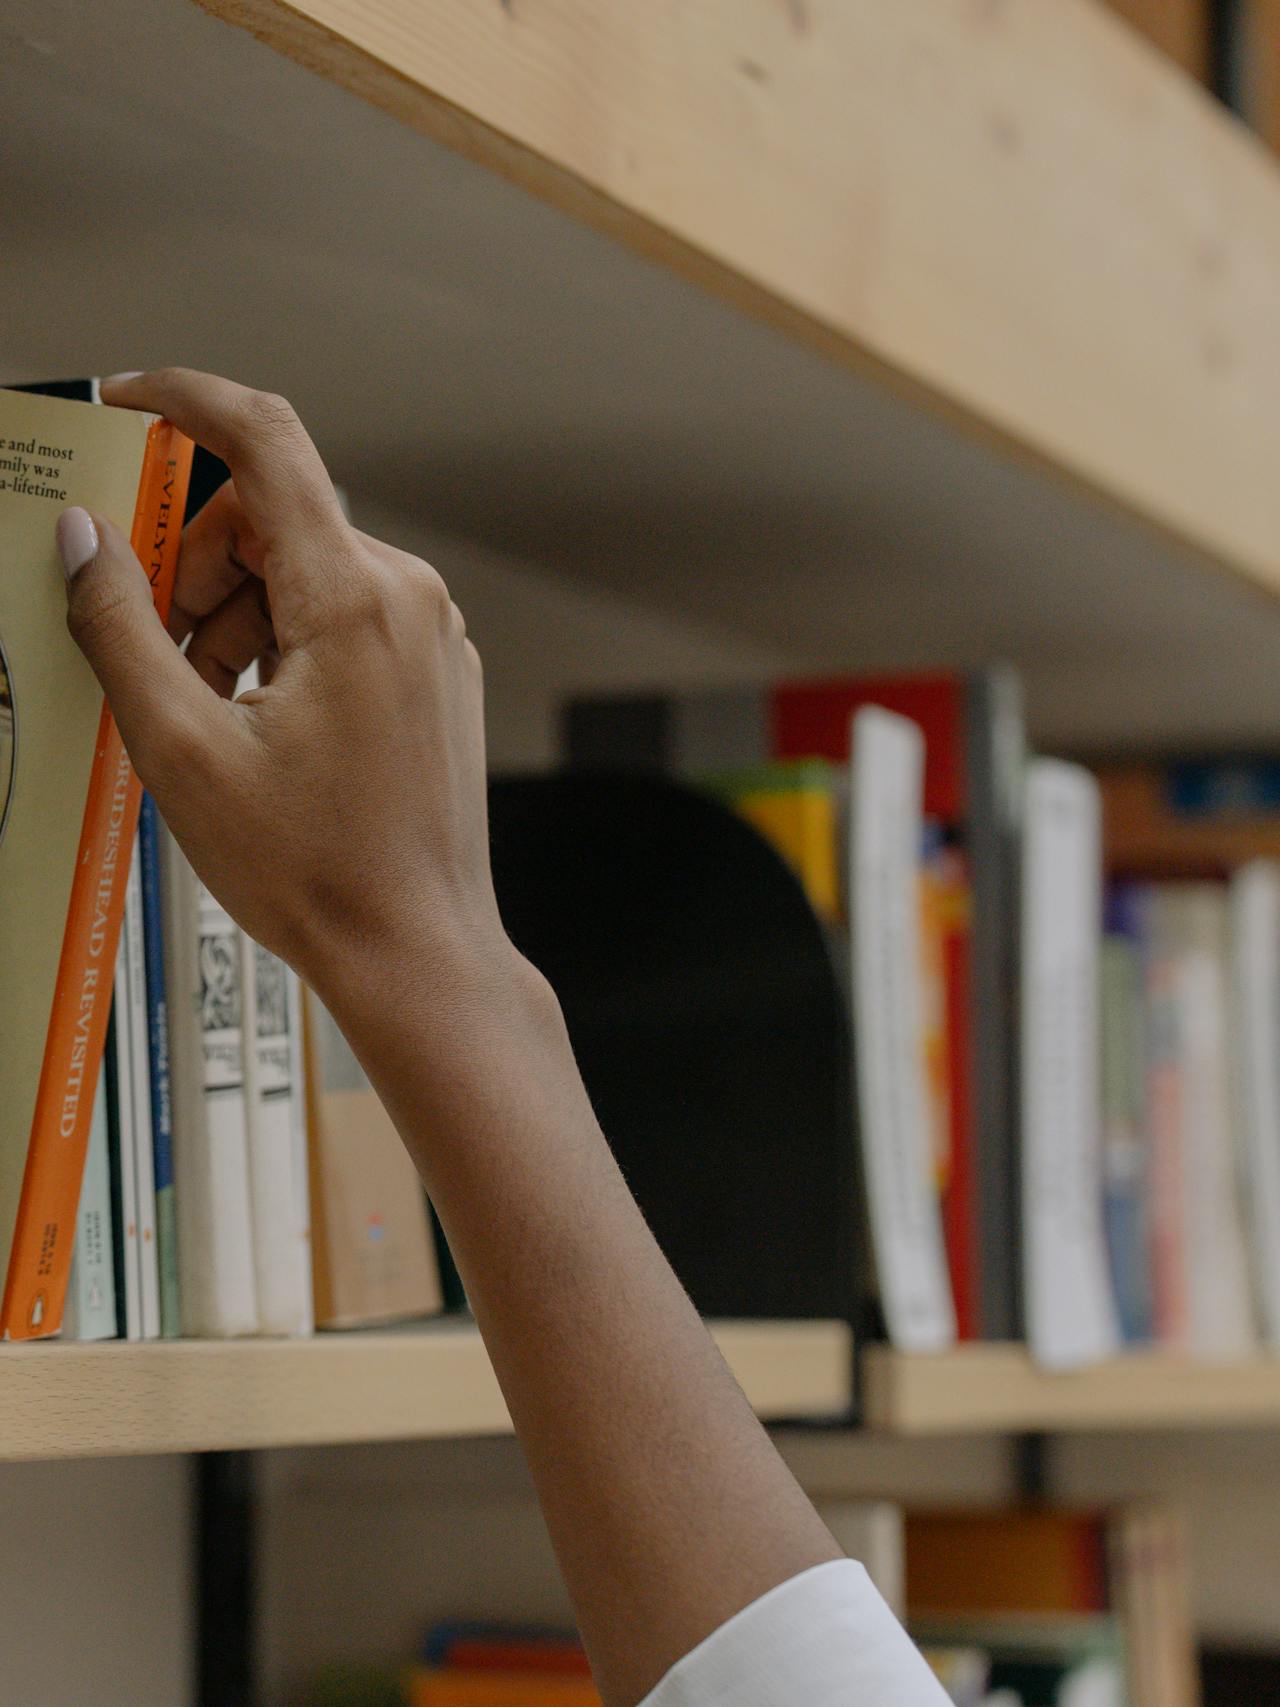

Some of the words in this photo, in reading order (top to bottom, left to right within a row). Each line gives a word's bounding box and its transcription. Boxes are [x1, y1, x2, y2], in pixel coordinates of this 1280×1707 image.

[8, 439, 35, 454] and
[37, 445, 73, 460] most
[33, 464, 60, 479] was
[150, 459, 178, 588] EVELYN
[89, 747, 131, 958] BRIDESHEAD
[59, 967, 100, 1138] REVISITED
